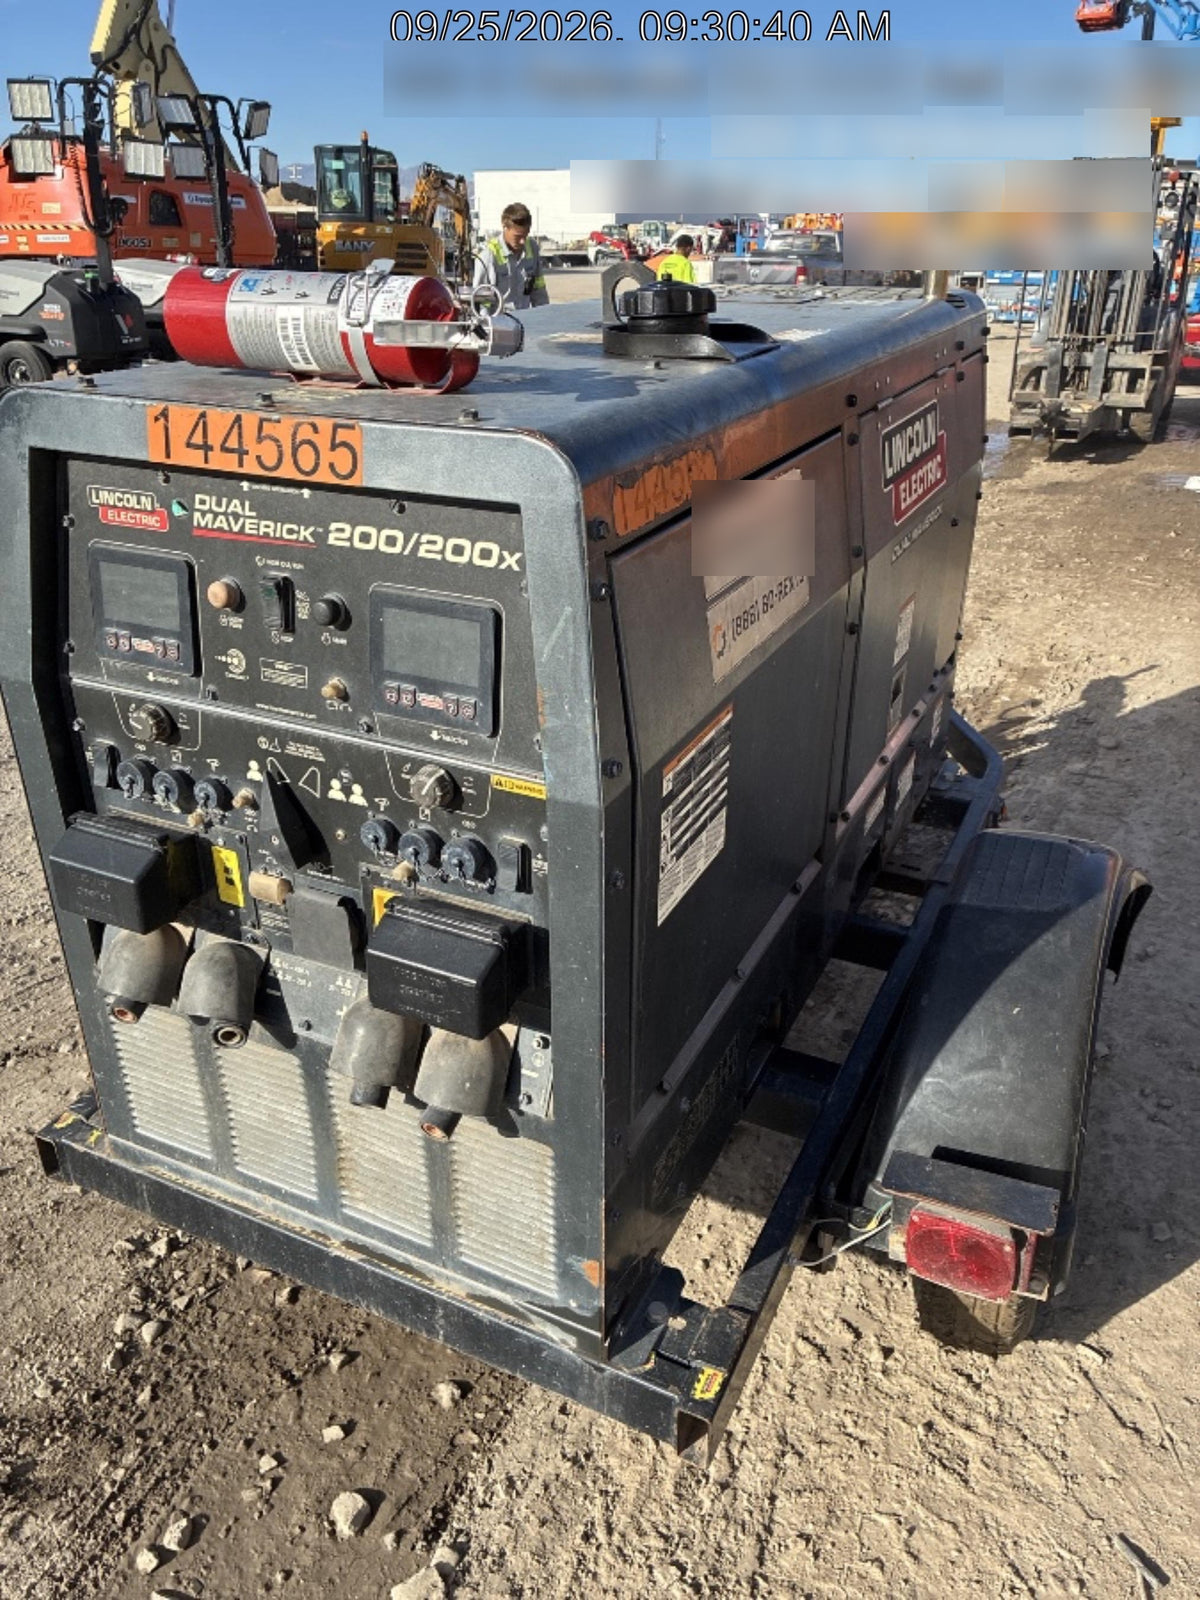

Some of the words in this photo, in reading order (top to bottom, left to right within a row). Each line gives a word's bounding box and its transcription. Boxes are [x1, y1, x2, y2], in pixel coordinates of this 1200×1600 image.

[154, 405, 358, 481] 144565
[885, 410, 937, 479] LINCOLN
[91, 488, 153, 511] LINCOLN
[900, 454, 942, 511] ELECTRIC
[107, 508, 161, 528] ELECTRIC
[194, 493, 257, 516] DUAL
